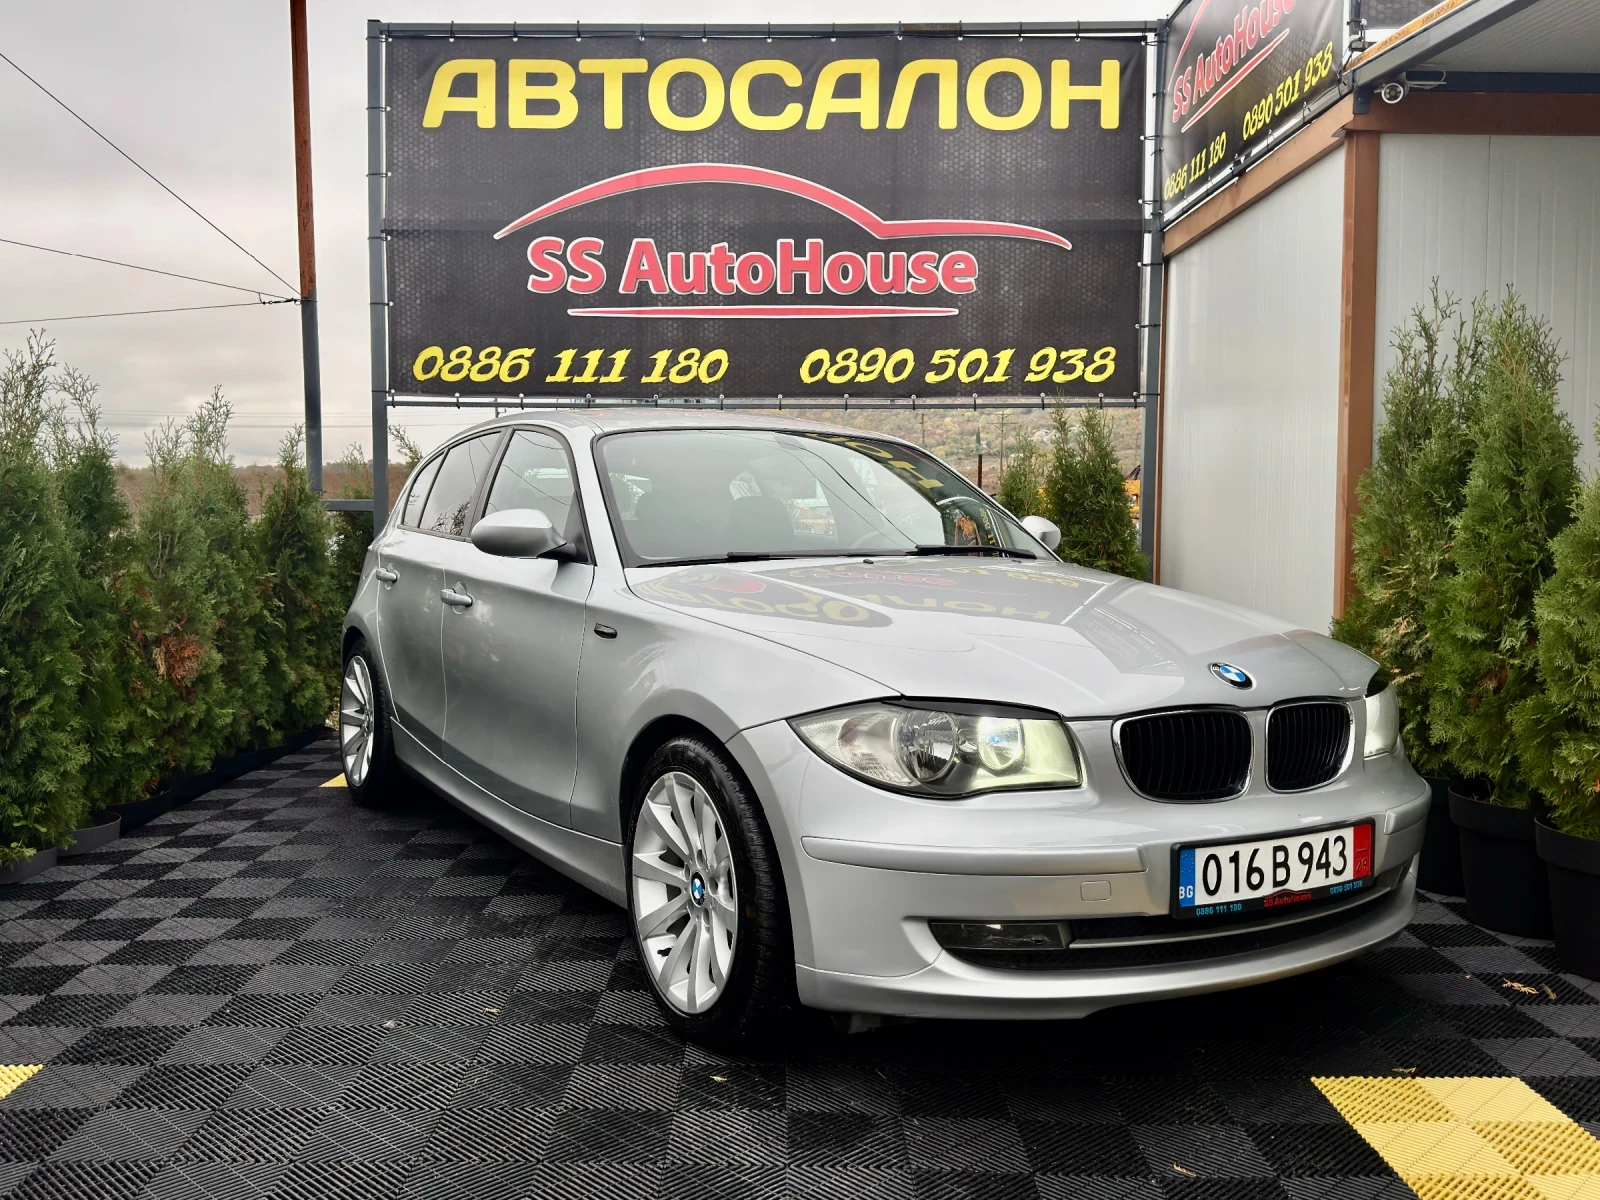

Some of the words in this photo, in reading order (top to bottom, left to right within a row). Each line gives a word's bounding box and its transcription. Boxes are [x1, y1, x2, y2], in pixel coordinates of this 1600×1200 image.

[422, 58, 1120, 132] АВТОСАЛОН
[1172, 66, 1192, 123] SS
[1243, 93, 1274, 141] 0890
[1274, 68, 1301, 116] 501
[1303, 41, 1333, 93] 938
[1164, 164, 1188, 201] 0886
[1189, 148, 1207, 184] 111
[1208, 131, 1227, 169] 180
[526, 236, 606, 295] SS
[619, 238, 979, 295] AutoHouse
[412, 345, 536, 383] 0886
[545, 348, 631, 384] 111
[640, 347, 730, 384] 180
[799, 347, 915, 384] 0890
[924, 348, 1016, 384] 501
[1025, 346, 1117, 384] 938
[1179, 885, 1194, 899] BG
[1215, 905, 1227, 913] 111
